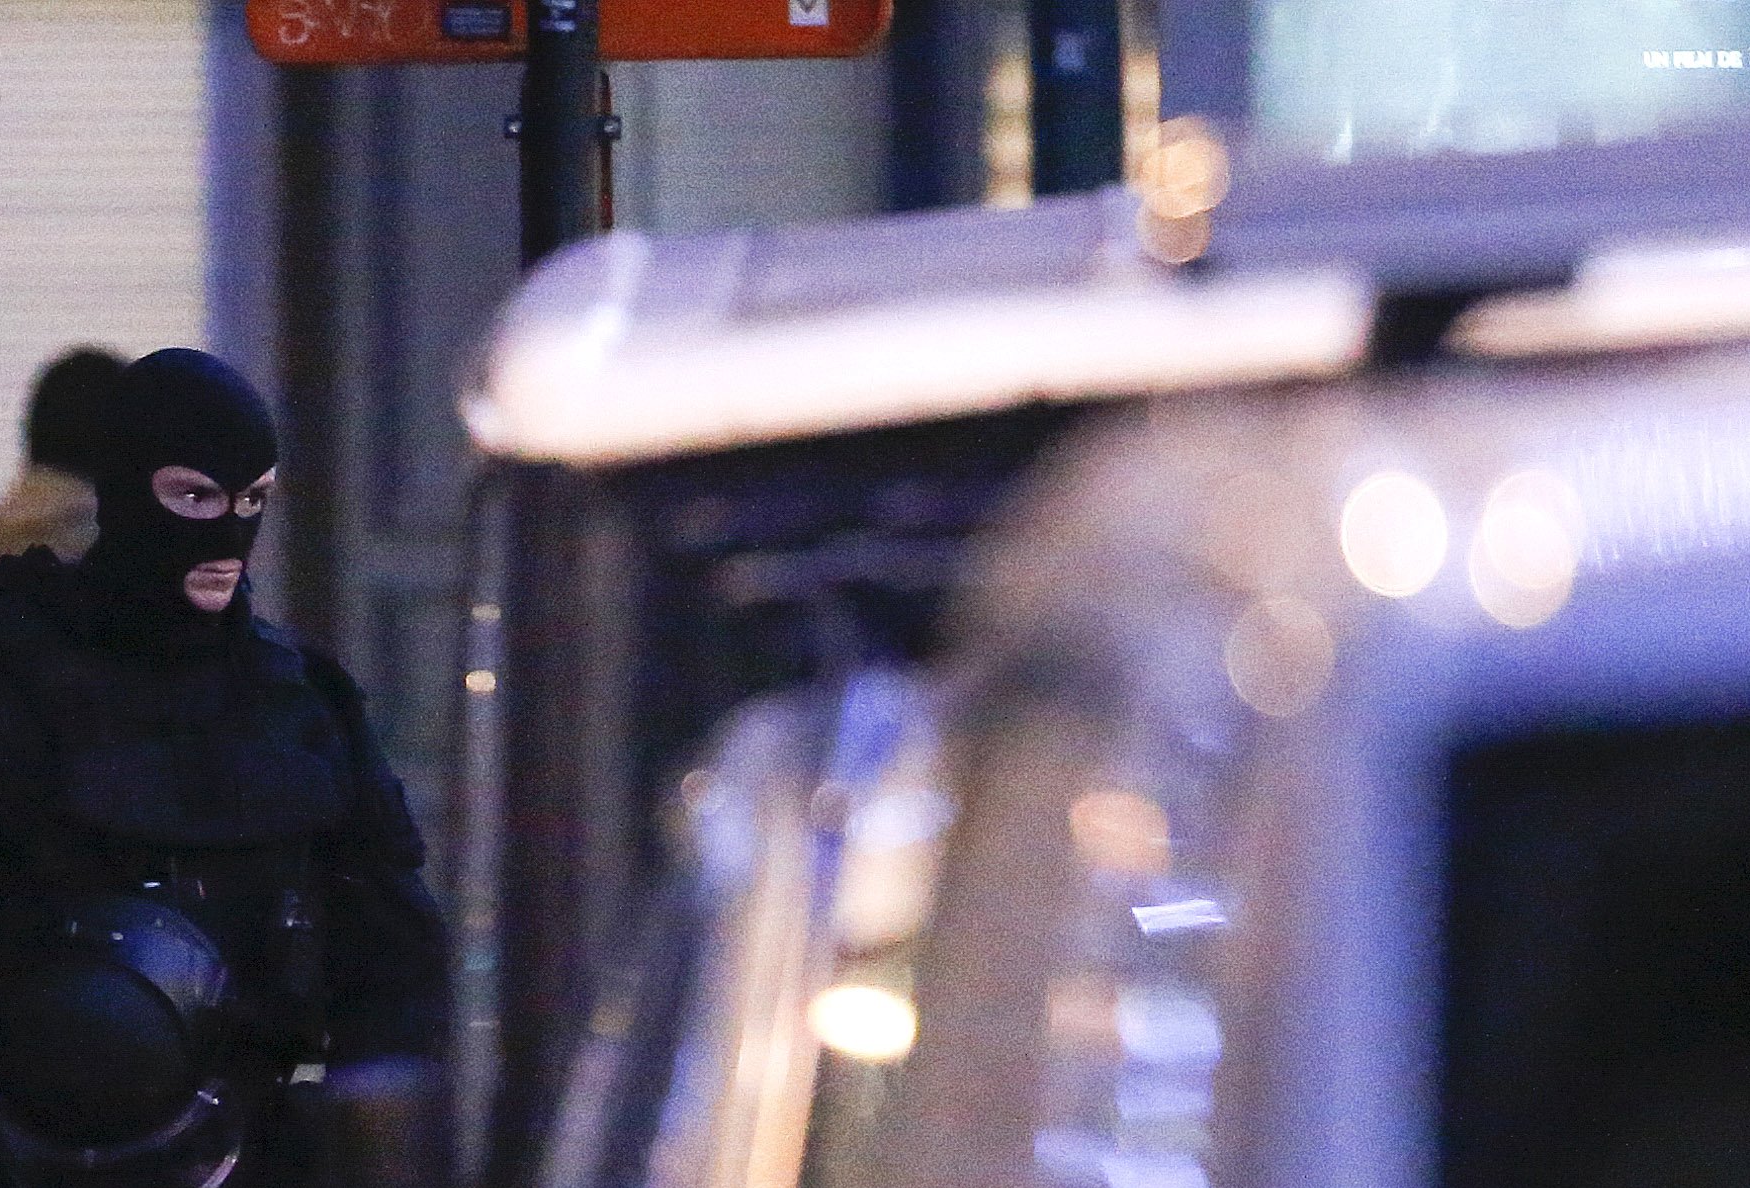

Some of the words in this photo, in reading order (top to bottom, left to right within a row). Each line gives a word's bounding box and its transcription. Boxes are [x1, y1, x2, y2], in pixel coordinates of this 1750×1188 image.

[1643, 50, 1669, 68] UN
[1673, 50, 1713, 68] FILM
[1716, 50, 1743, 68] DE
